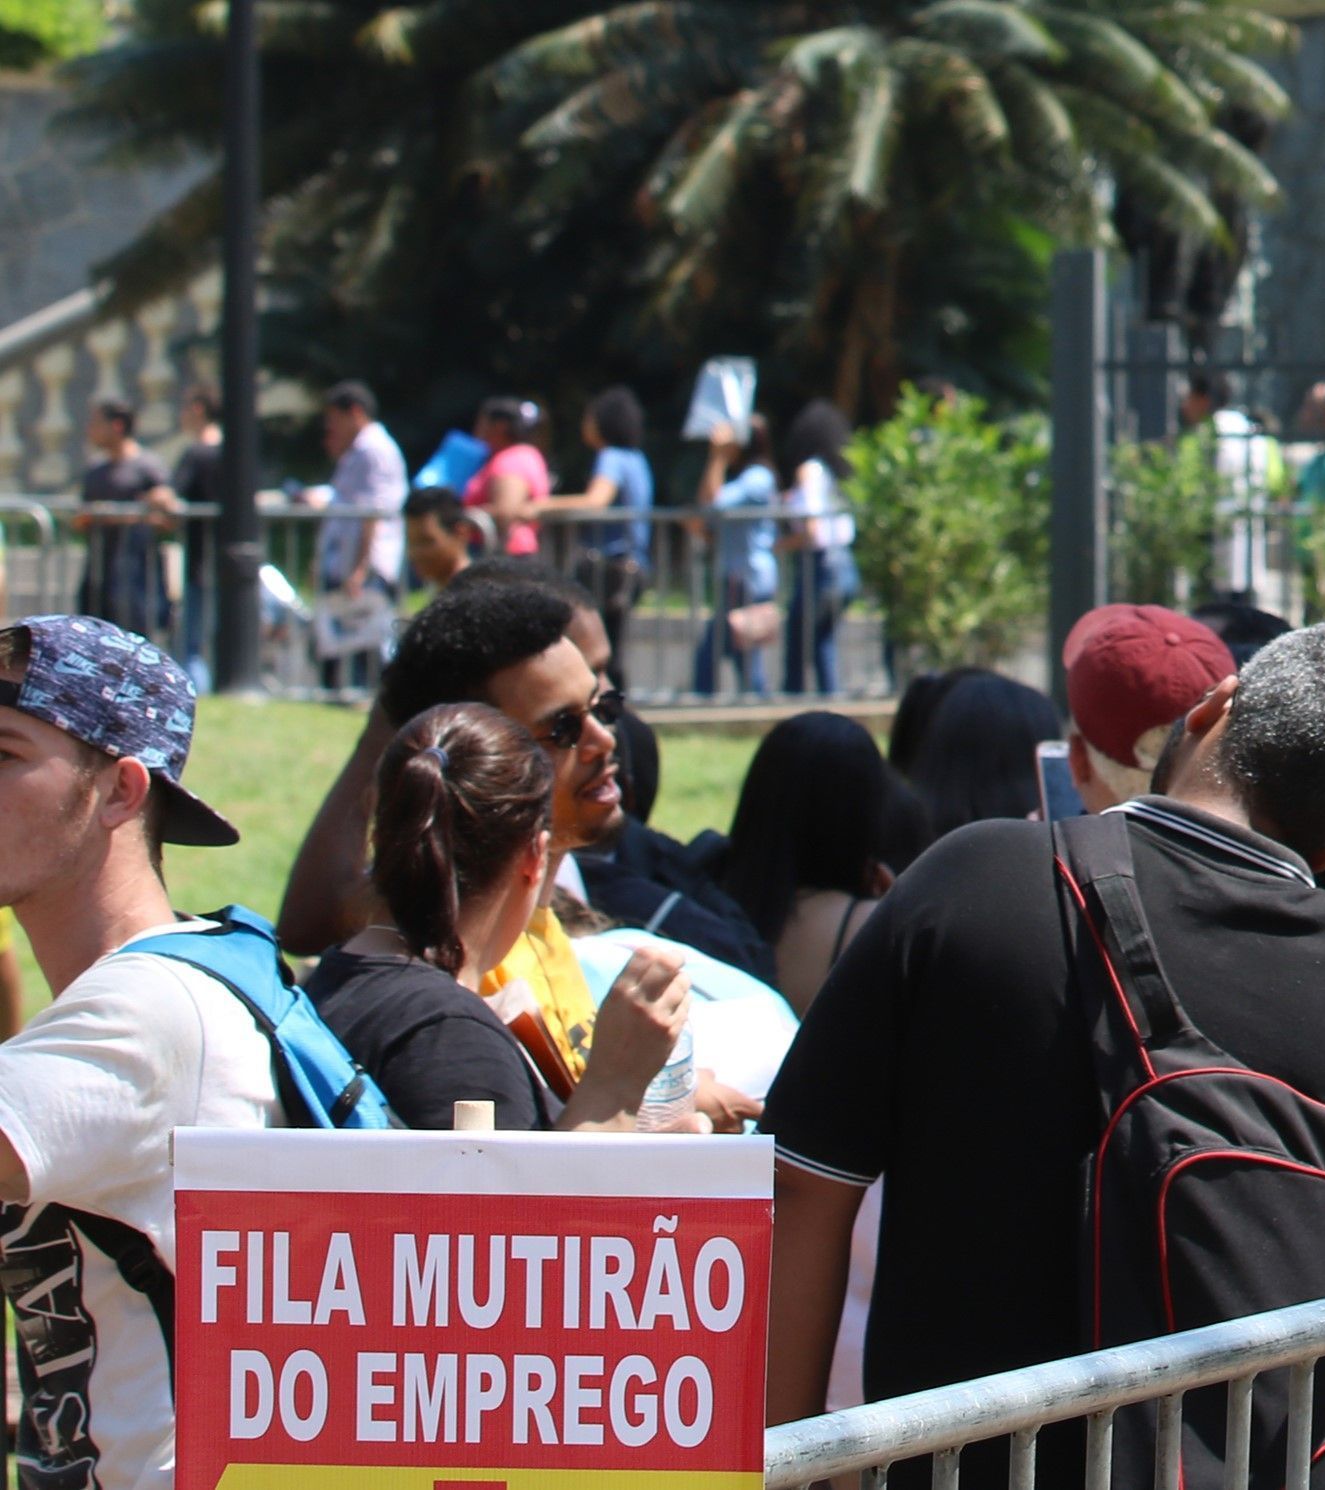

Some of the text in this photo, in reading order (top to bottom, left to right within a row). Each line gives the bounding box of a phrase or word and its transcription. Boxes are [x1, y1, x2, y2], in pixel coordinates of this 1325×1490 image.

[201, 1214, 746, 1333] FILA MUTIRÃO
[229, 1349, 714, 1448] DO EMPREGO
